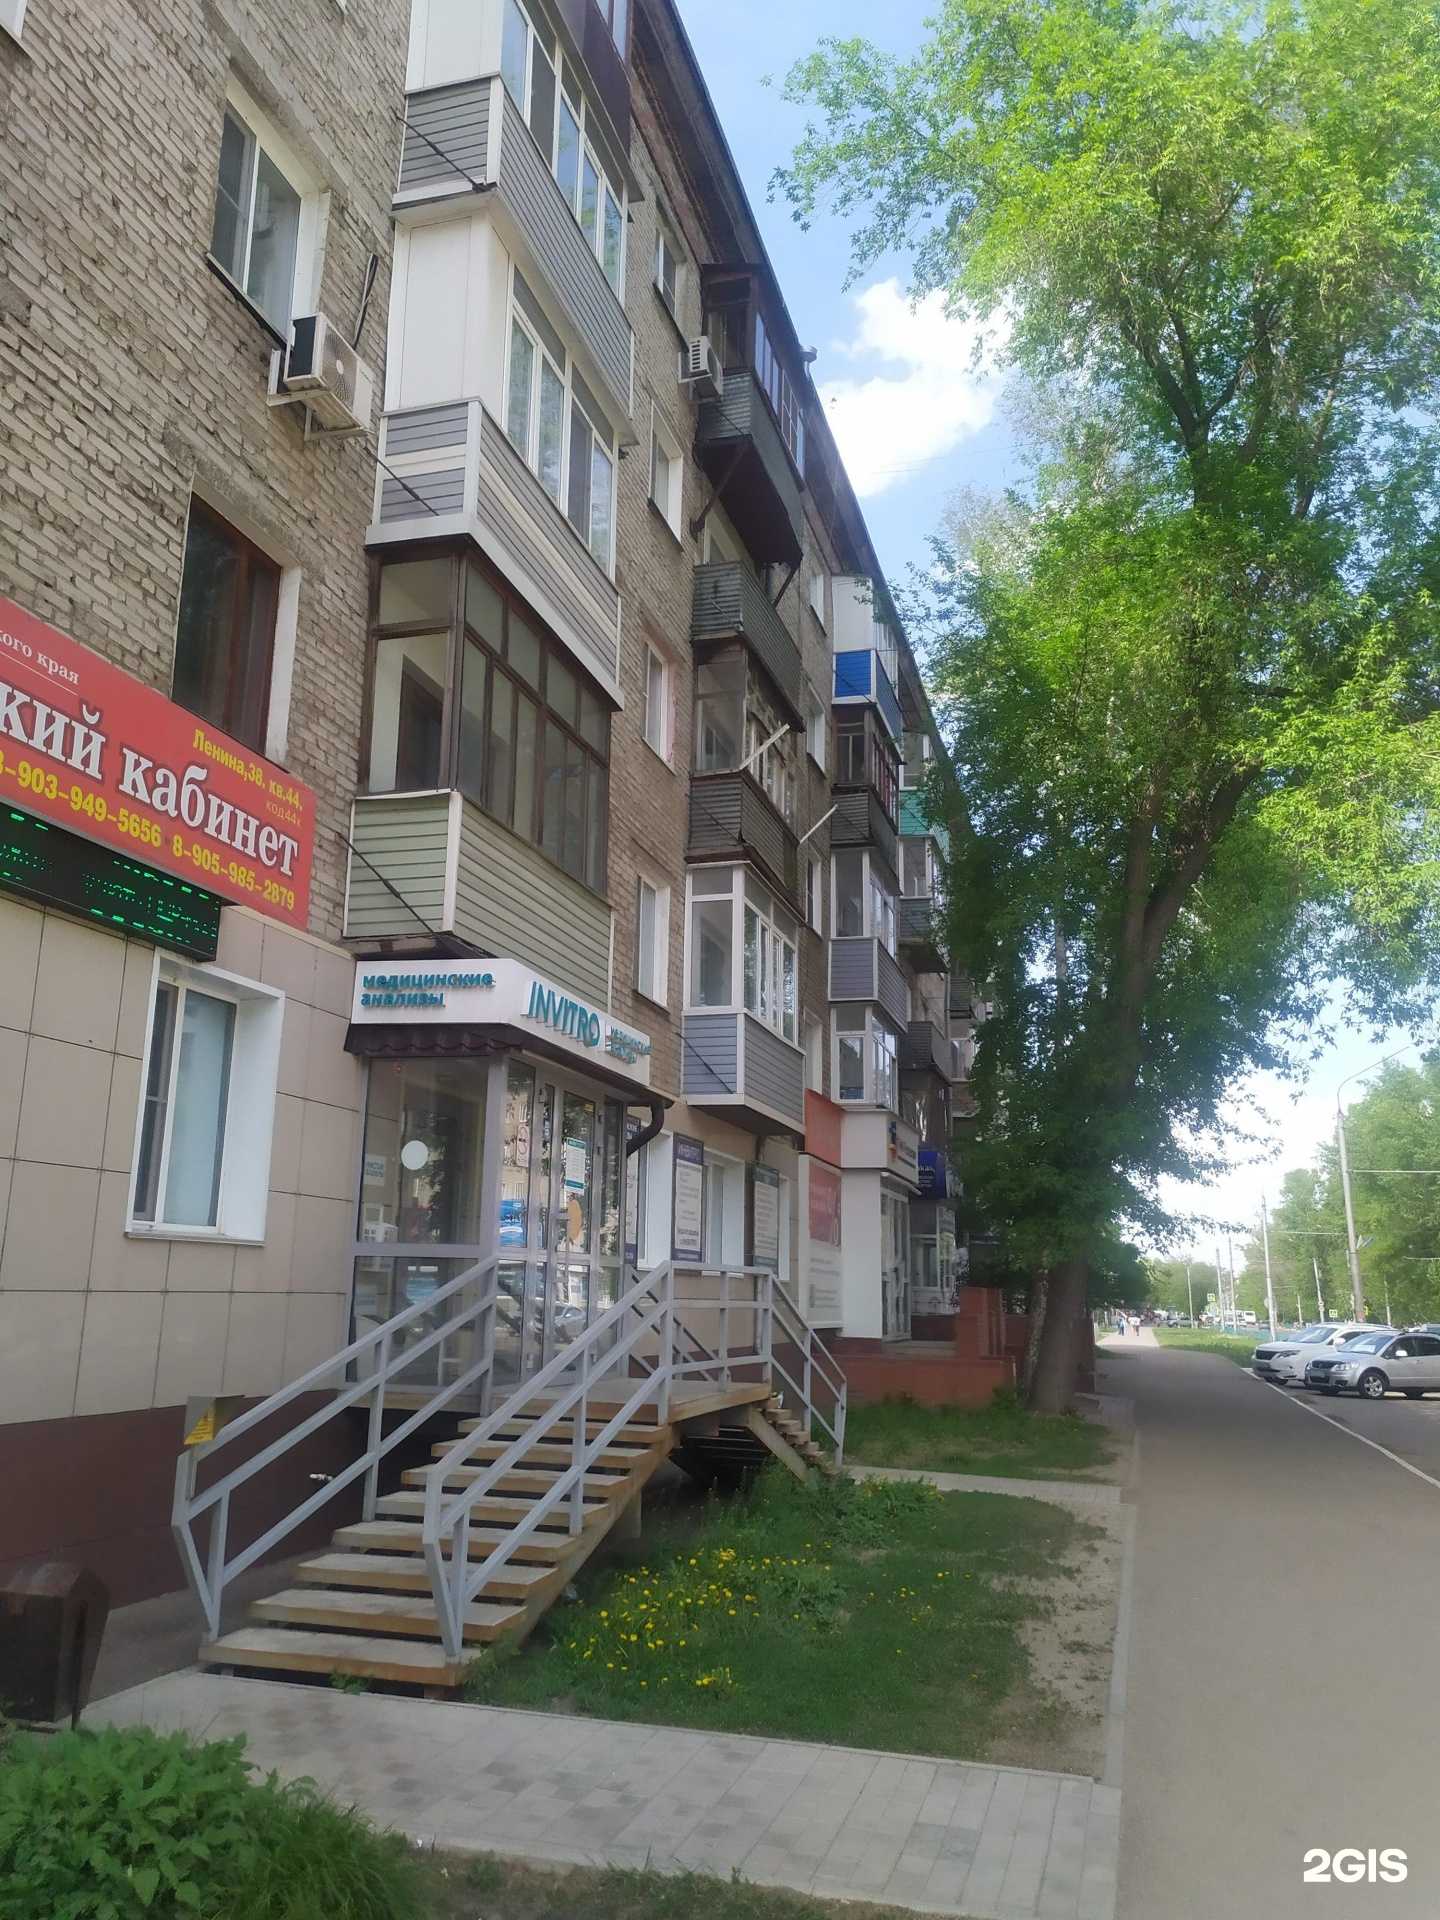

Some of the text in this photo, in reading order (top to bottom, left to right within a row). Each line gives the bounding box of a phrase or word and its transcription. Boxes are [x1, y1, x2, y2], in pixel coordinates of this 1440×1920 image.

[0, 630, 80, 685] ого края
[118, 747, 299, 877] кабинет
[172, 833, 296, 912] 8-905-985-2879
[360, 992, 446, 1007] анализы
[362, 973, 495, 990] медицинские
[527, 981, 601, 1048] INVITRO
